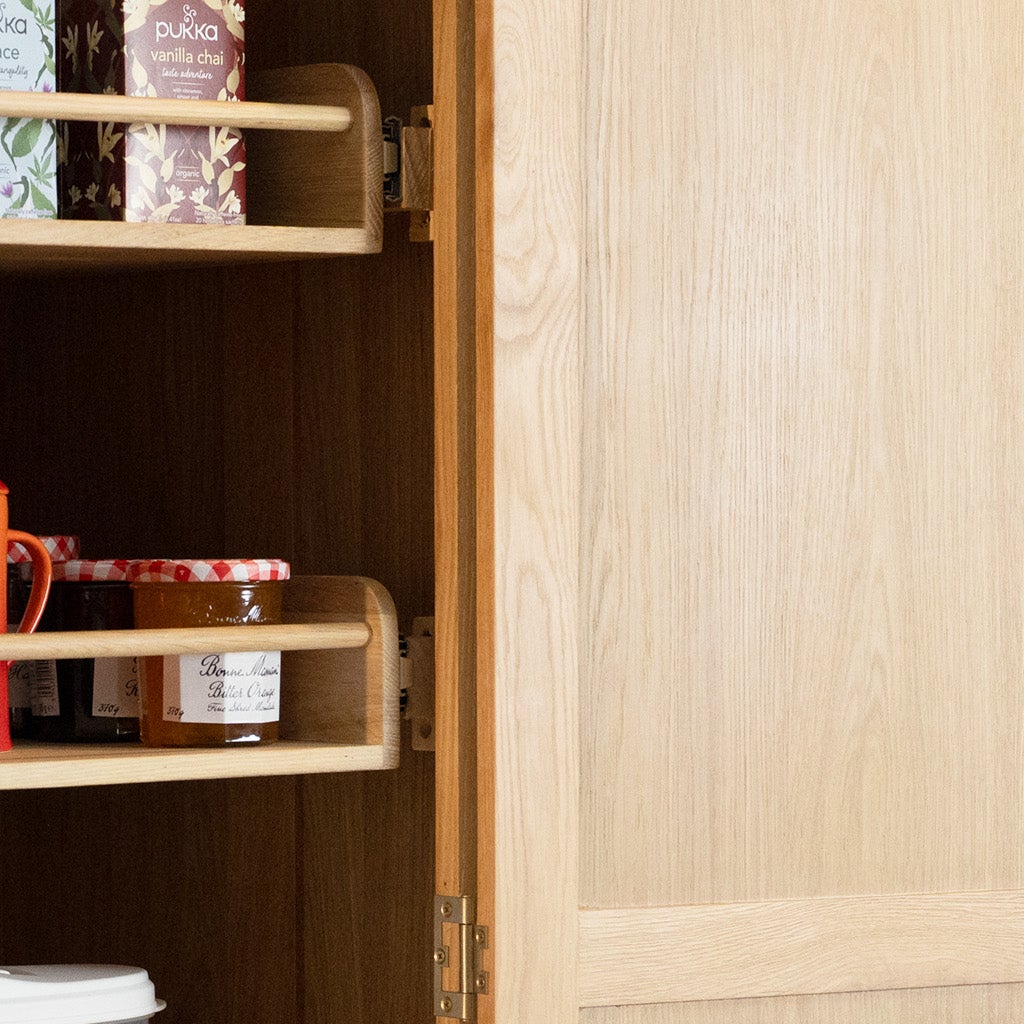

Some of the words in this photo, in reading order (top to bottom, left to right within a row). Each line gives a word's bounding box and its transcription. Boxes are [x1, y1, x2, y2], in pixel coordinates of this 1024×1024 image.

[156, 17, 218, 42] pukka
[150, 47, 193, 63] vanilla
[197, 49, 224, 65] chai
[162, 67, 179, 78] taste
[176, 169, 200, 179] organic
[199, 654, 244, 677] Bonne
[207, 680, 243, 698] Bitter
[207, 702, 225, 712] Fine
